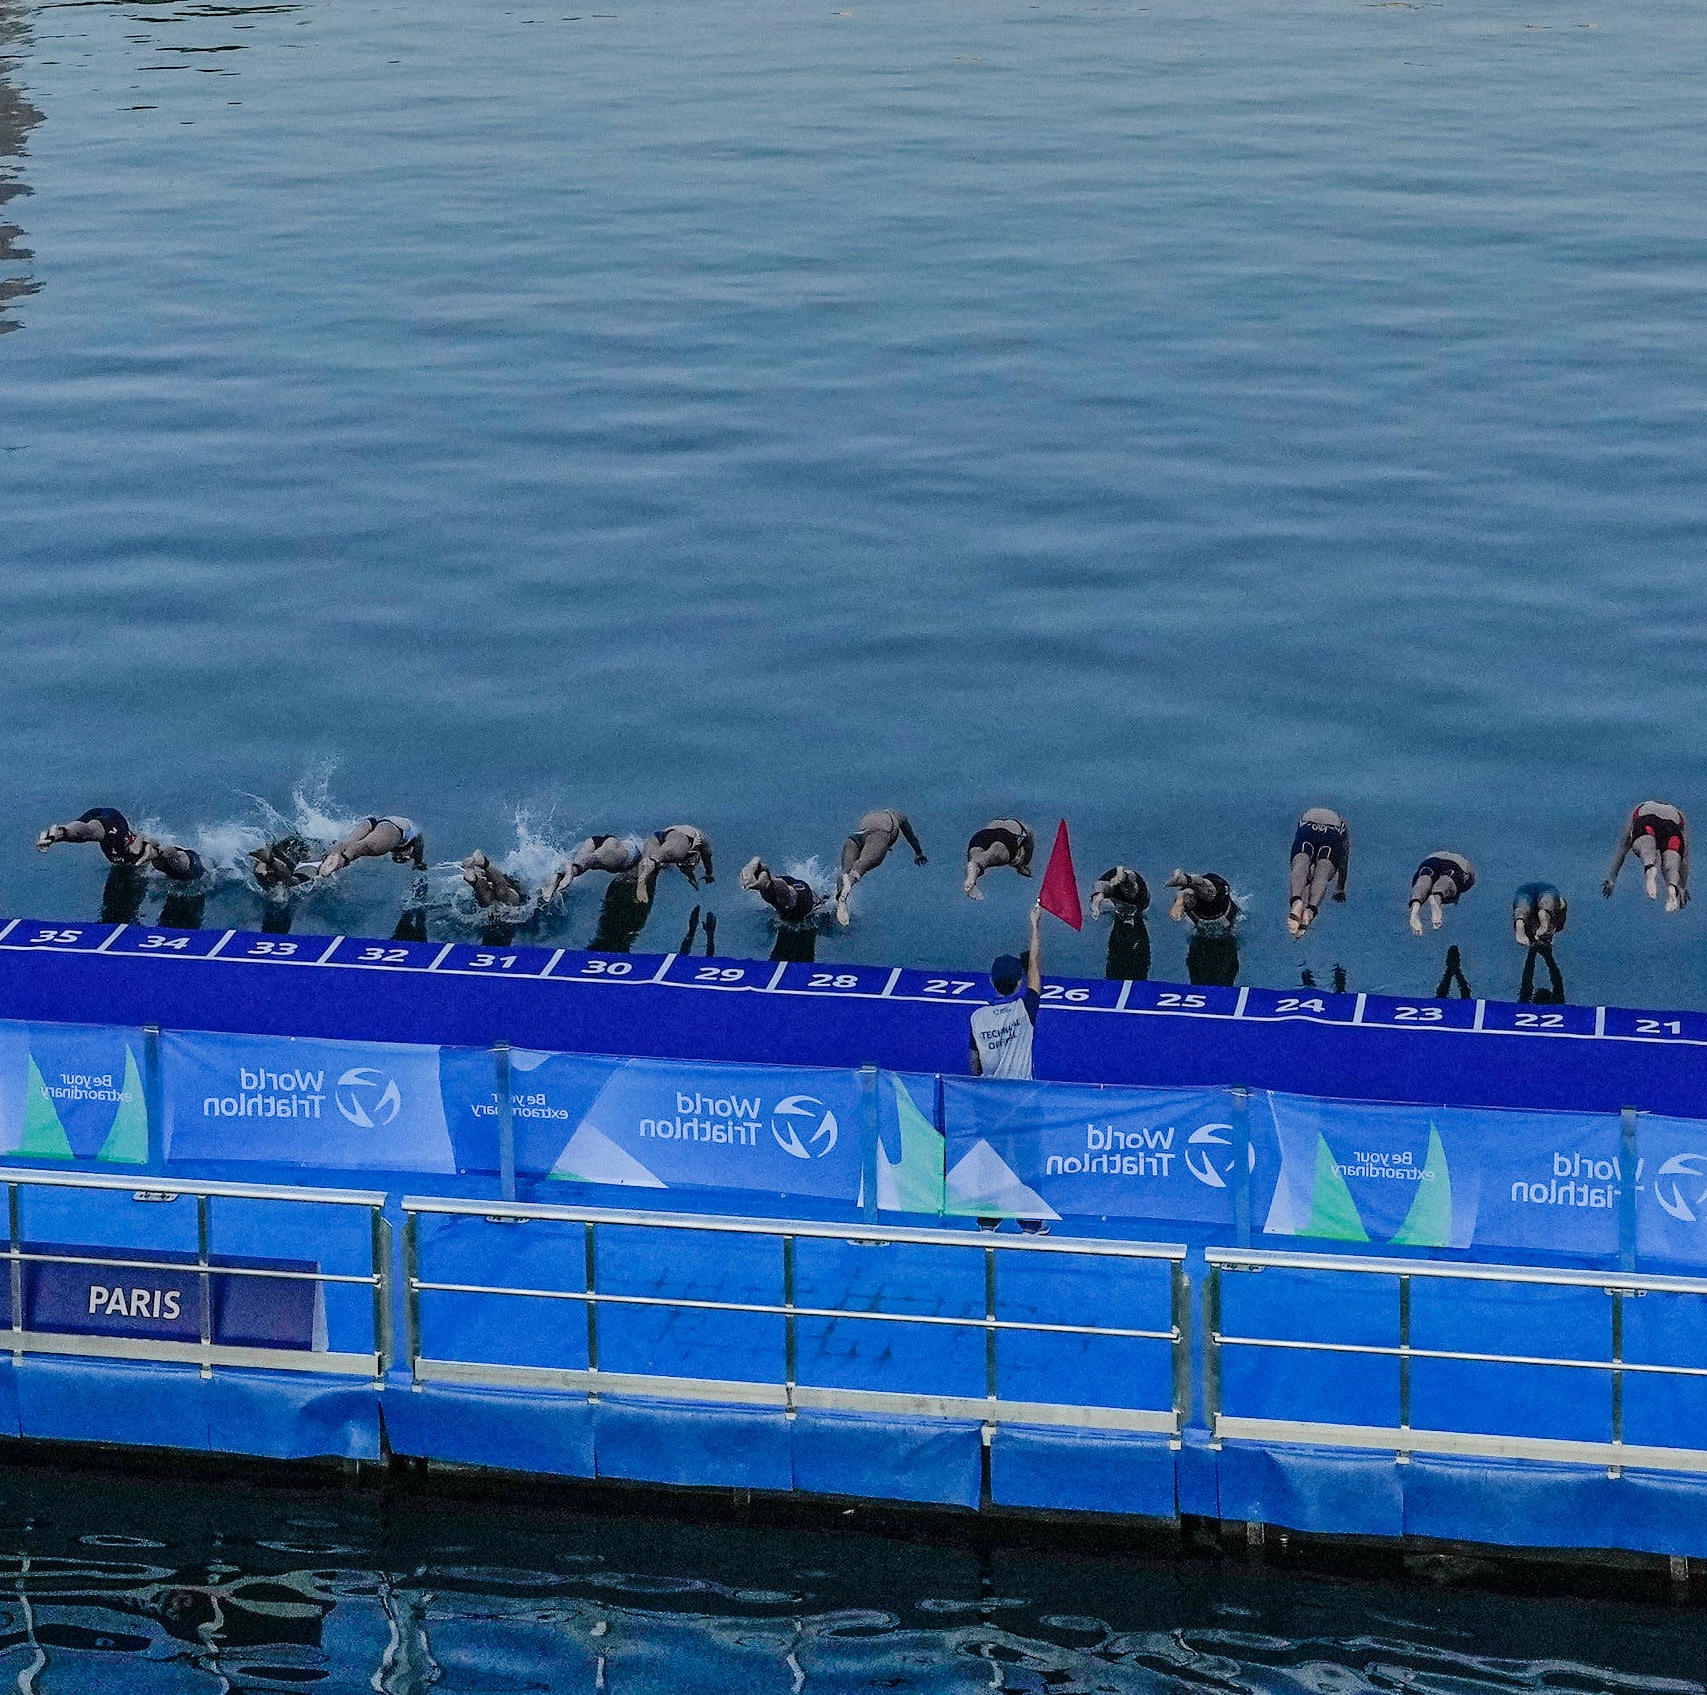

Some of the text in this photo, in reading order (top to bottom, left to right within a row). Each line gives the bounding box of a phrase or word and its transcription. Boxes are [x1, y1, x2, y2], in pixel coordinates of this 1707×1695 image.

[30, 930, 83, 943] 35
[138, 935, 190, 950] 34
[247, 942, 298, 956] 33
[357, 947, 409, 962] 32
[468, 954, 518, 969] 31
[580, 961, 633, 975] 30
[694, 967, 745, 982] 29
[807, 973, 859, 988] 28
[923, 979, 975, 995] 27
[1040, 986, 1090, 1001] 26
[1156, 993, 1207, 1008] 25
[1276, 998, 1326, 1013] 24
[1394, 1006, 1444, 1021] 23
[1515, 1013, 1565, 1028] 22
[1635, 1019, 1681, 1035] 21
[89, 1286, 181, 1320] PARIS
